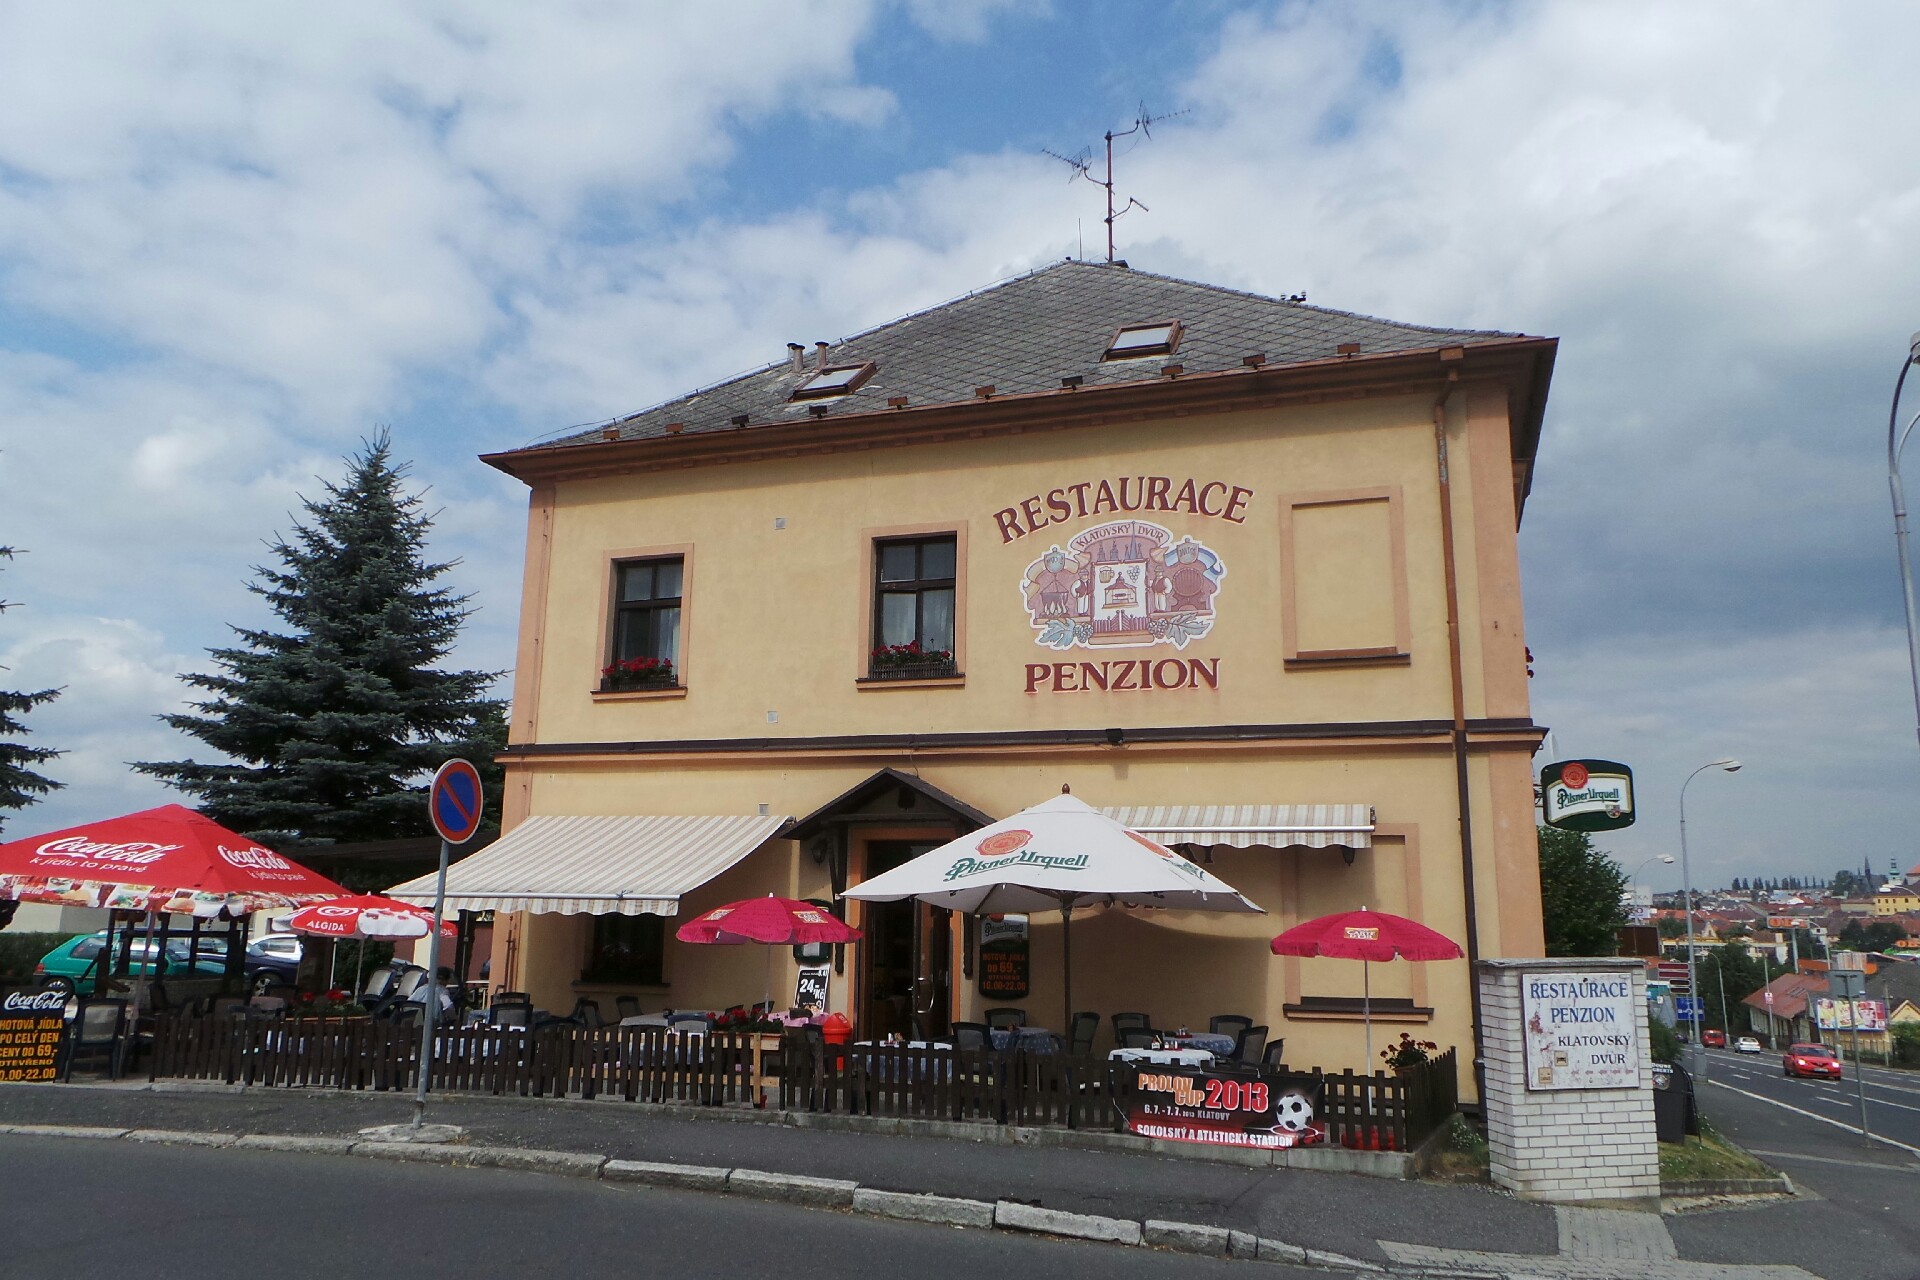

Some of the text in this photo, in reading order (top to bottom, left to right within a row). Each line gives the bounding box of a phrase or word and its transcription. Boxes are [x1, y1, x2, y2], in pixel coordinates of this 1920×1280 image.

[993, 476, 1254, 544] RESTAURACE
[1024, 658, 1221, 693] PENZION
[1557, 788, 1619, 809] Pilsner Urquell
[80, 860, 98, 868] to
[99, 863, 149, 873] pravé
[943, 850, 1090, 882] Pilsner Urquell
[306, 920, 344, 931] ALGIDA
[1530, 982, 1628, 998] RESTAURACE
[0, 1016, 63, 1030] HOTOVÁ JÍDLA
[1551, 1007, 1615, 1023] PENZION
[0, 1029, 60, 1044] PO CELÝ DEN
[1558, 1032, 1631, 1046] KLATOVSKÝ
[22, 1047, 34, 1057] OD
[1174, 1089, 1205, 1108] CUP
[1205, 1079, 1269, 1113] 2013
[1197, 1110, 1230, 1120] KLATOVY
[1137, 1124, 1293, 1147] SOKOLSKÝ A ATLETICKÝ STADION
